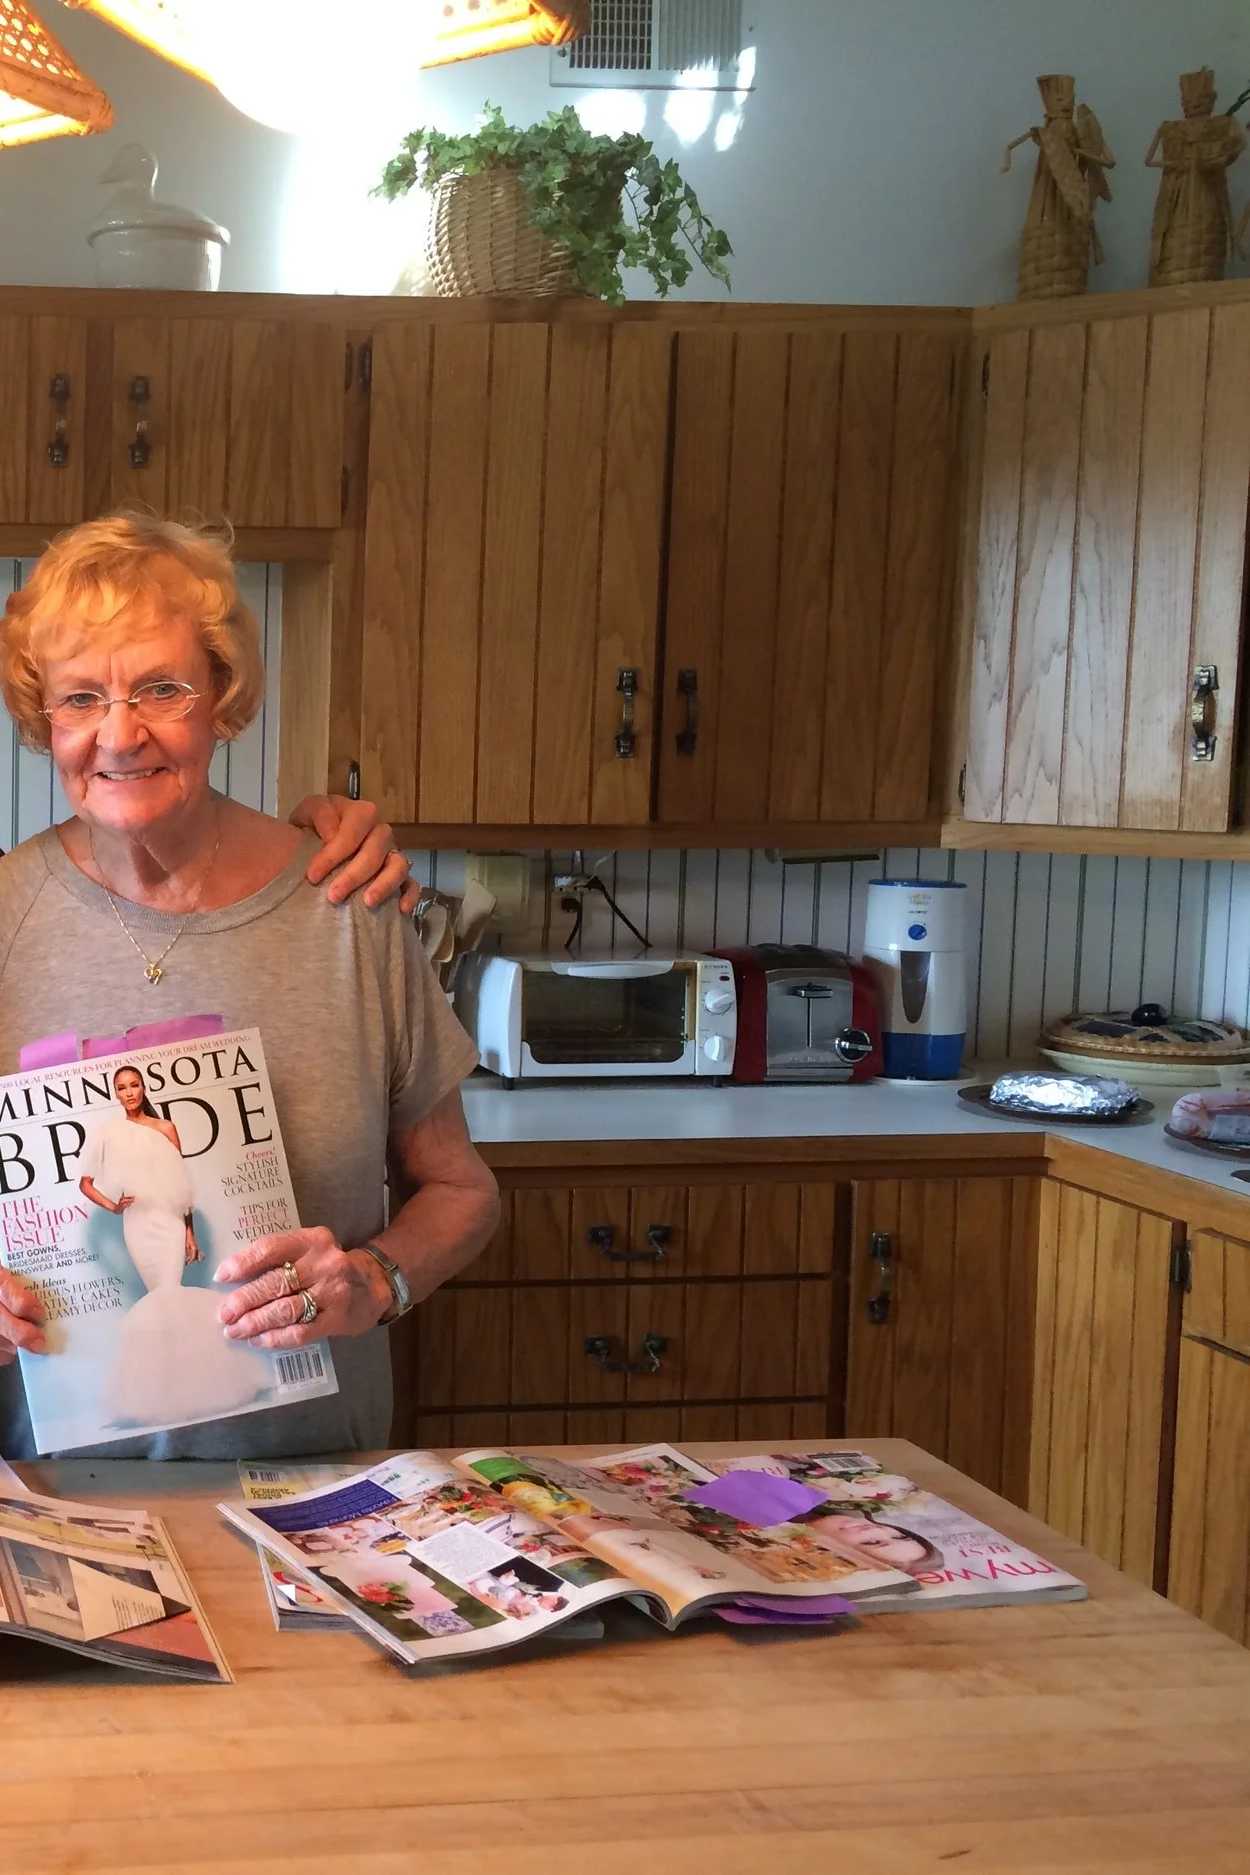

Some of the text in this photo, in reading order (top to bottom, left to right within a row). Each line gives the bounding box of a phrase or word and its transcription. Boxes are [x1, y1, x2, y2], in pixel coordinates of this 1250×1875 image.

[14, 1076, 41, 1087] LOCAL
[44, 1065, 94, 1081] RESOURCES
[95, 1061, 113, 1071] FOR
[114, 1053, 156, 1067] PLANNING
[157, 1047, 182, 1059] YOUR
[182, 1042, 211, 1054] DREAM
[236, 1156, 279, 1172] STYLISH
[221, 1167, 279, 1186] SIGNATURE
[224, 1178, 284, 1197] COCKTAILS
[240, 1197, 288, 1215] TIPS FOR
[2, 1202, 89, 1236] FASHION
[238, 1208, 289, 1228] PERFECT
[5, 1226, 65, 1252] ISSUE
[233, 1220, 292, 1240] WEDDING
[7, 1251, 27, 1261] BEST
[8, 1248, 86, 1269] BRIDESMAID DRESSES
[10, 1253, 100, 1277] MENSWEAR AND MORE!
[24, 1277, 67, 1291] esh Ideas
[34, 1287, 71, 1300] ULOUS
[43, 1287, 122, 1310] ATIVE CAKES
[46, 1304, 81, 1320] EAMY
[914, 1558, 1058, 1584] mywe
